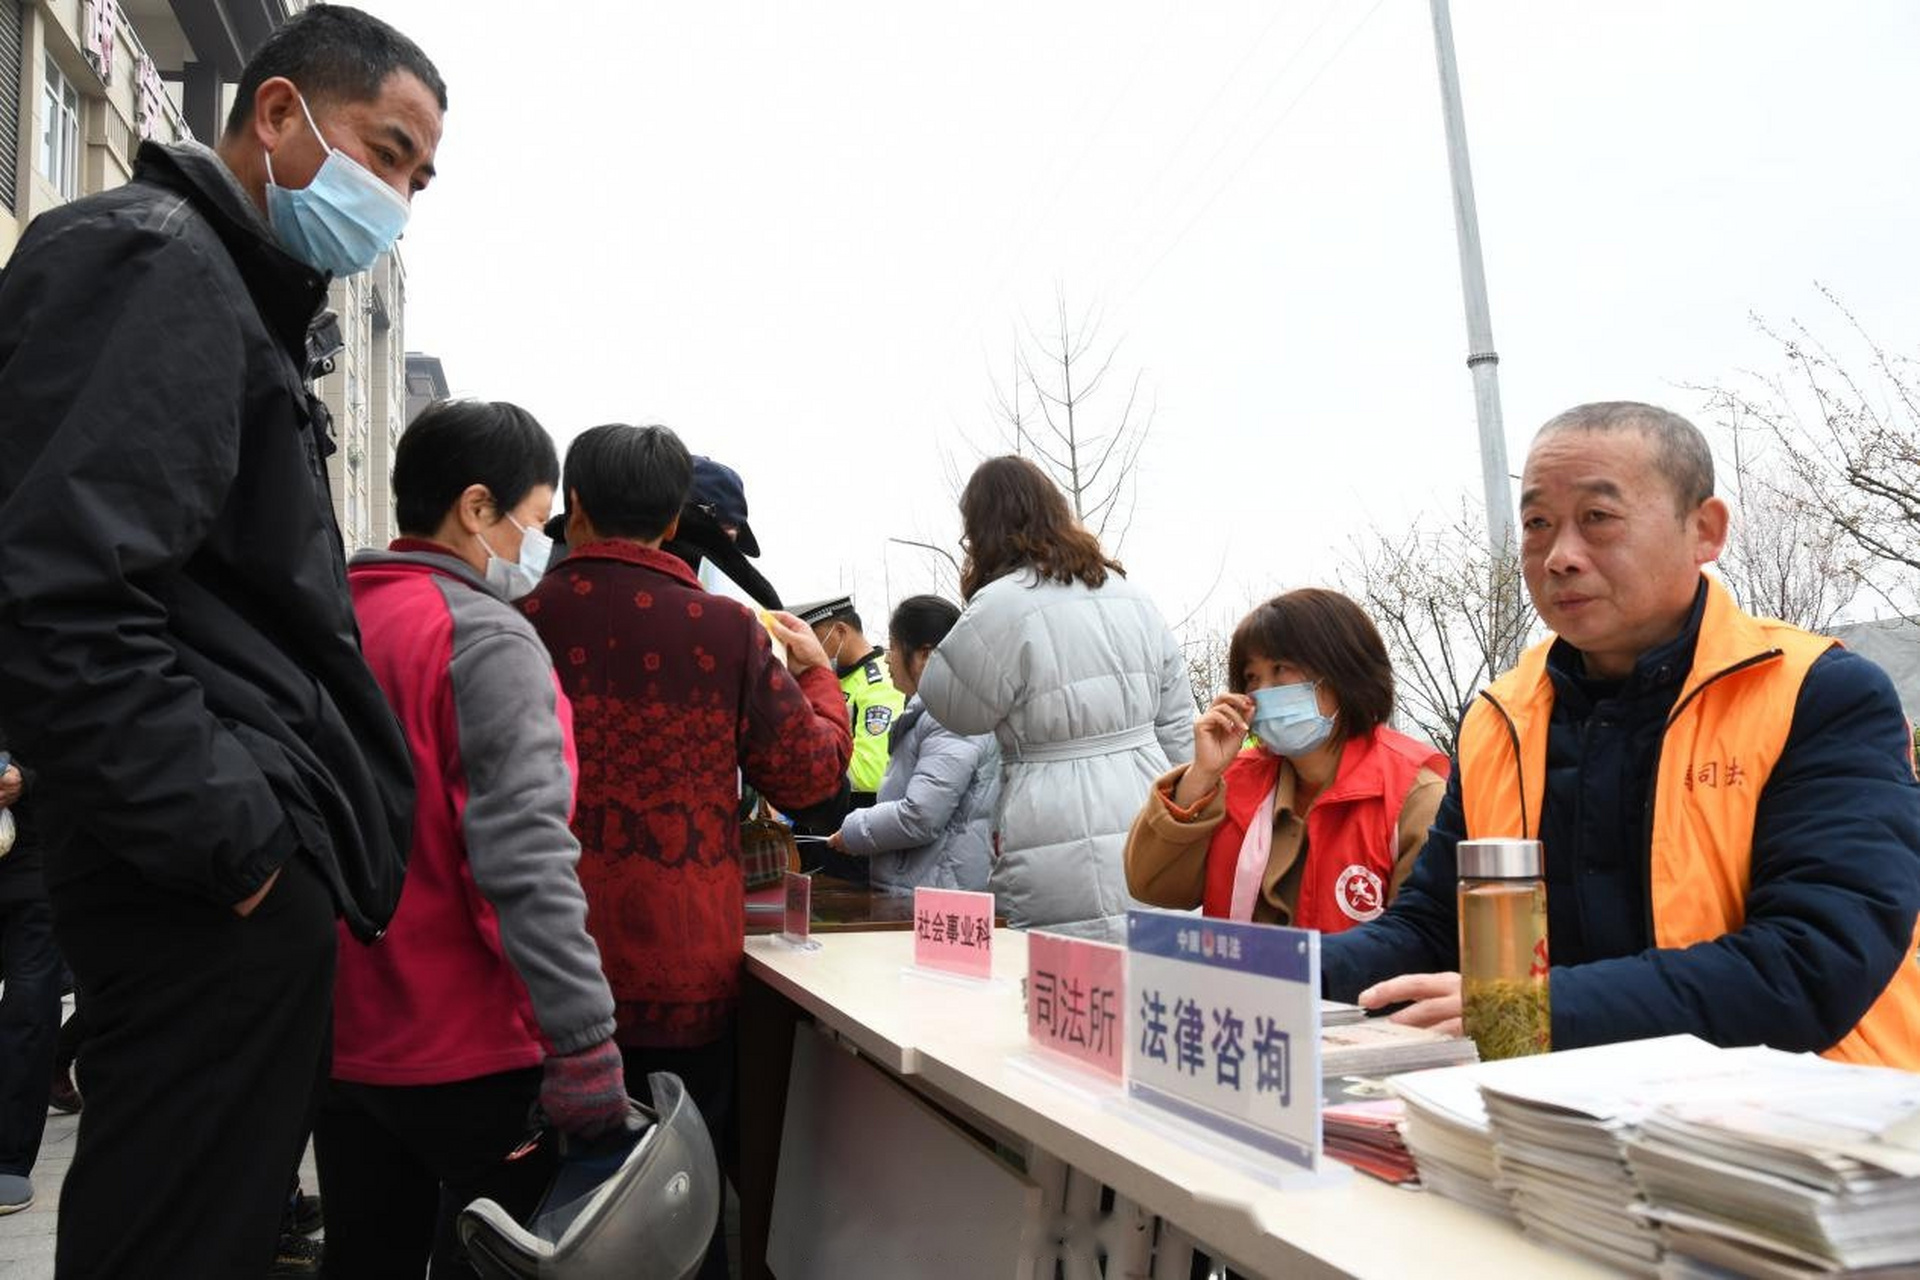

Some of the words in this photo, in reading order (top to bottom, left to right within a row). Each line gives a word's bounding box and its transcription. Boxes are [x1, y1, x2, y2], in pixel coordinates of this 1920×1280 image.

[917, 909, 991, 950] 社会事业科
[1035, 969, 1116, 1058] 司法所
[1140, 988, 1291, 1108] 法律咨询
